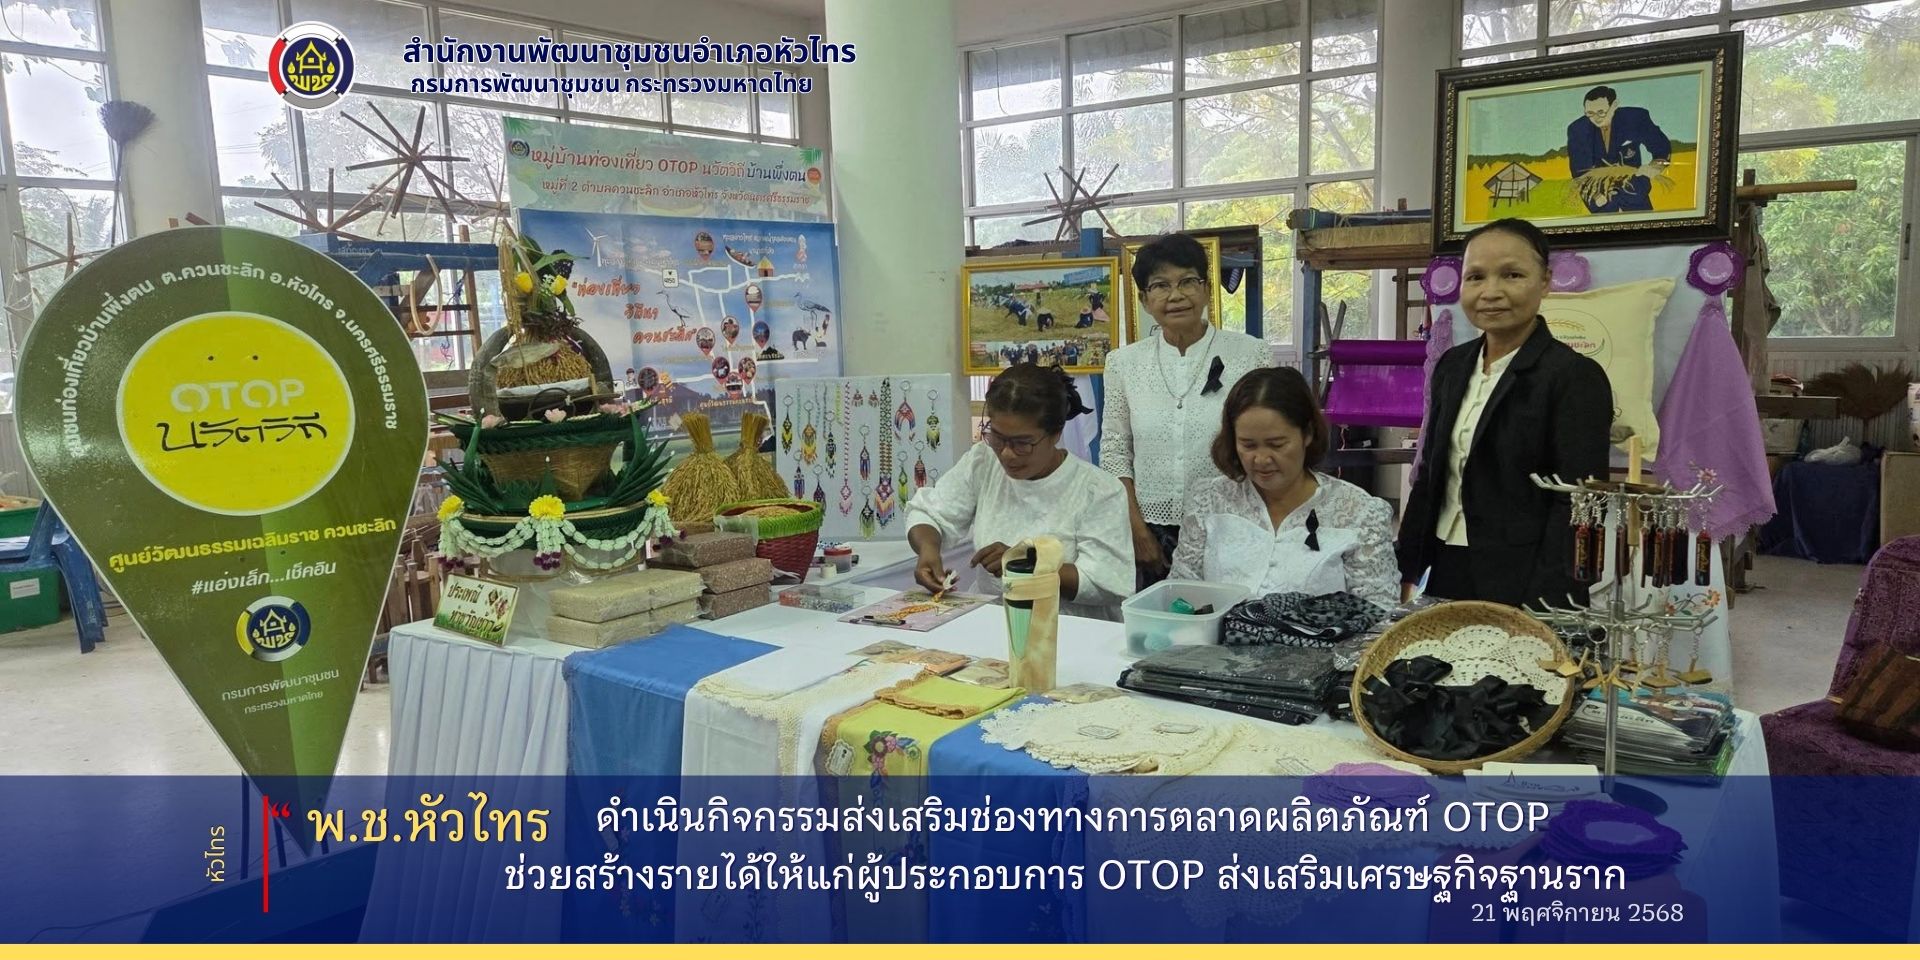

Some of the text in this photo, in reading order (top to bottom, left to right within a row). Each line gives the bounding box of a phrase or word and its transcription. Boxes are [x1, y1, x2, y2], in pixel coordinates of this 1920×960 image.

[531, 144, 653, 172] หมู่บ้านท่องเที่ยว
[658, 157, 698, 174] OTOP
[702, 160, 745, 177] นวัตวิถี
[747, 160, 807, 182] บ้านพึ่งตน
[571, 181, 578, 192] 2
[581, 180, 659, 197] ตำบลควนชะลิก
[662, 185, 718, 200] อำเภอหัวไทร
[161, 262, 265, 285] ต.ควนชะลิก
[270, 270, 334, 311] อ.หัวไทร
[336, 307, 397, 429] จ.นครศรีธรรมราช
[170, 378, 305, 414] OTOP
[156, 412, 327, 452] นวัตวิถี
[109, 517, 397, 573] ศูนย์วัฒนธรรมเฉลิมราช ควนชะลิก
[447, 581, 484, 604] ประเพณี
[221, 668, 340, 701] กรมการพัฒนาชุมชน
[244, 690, 323, 714] กระทรวงมหาดไทย
